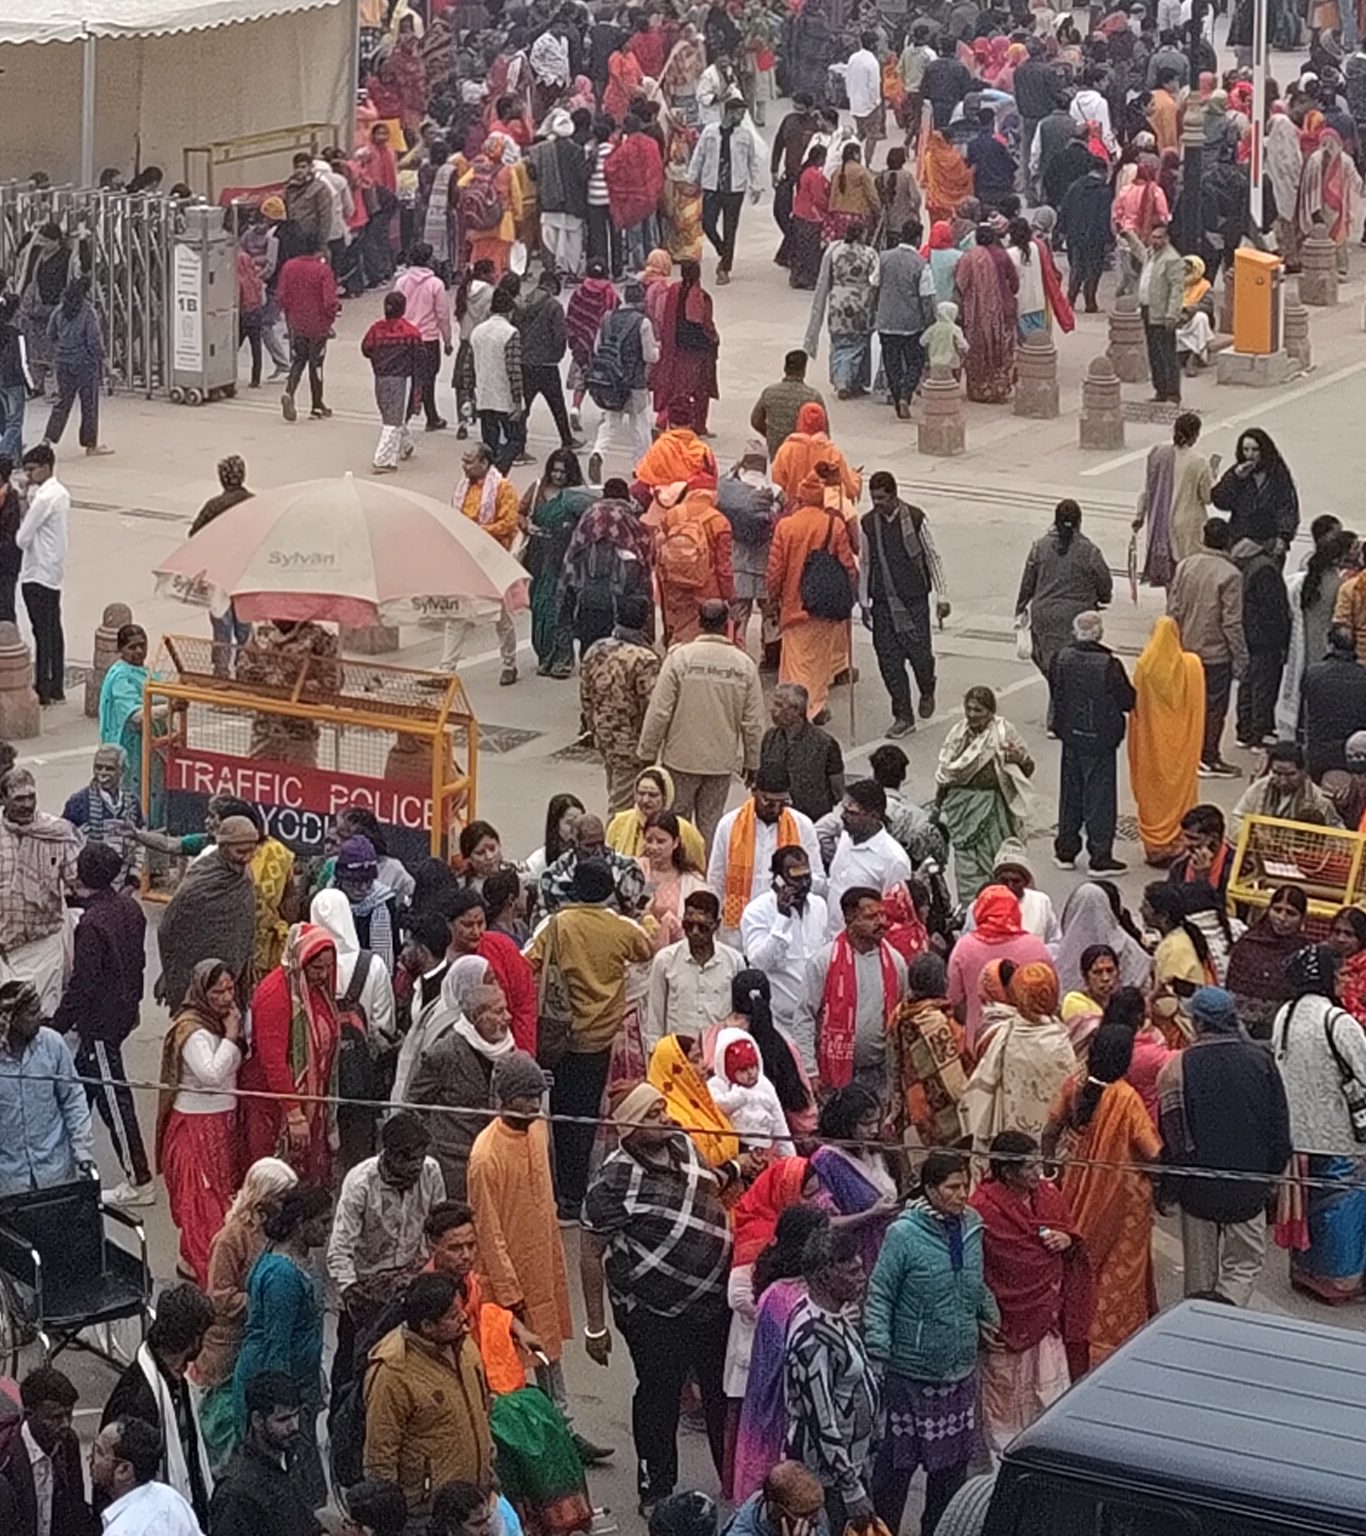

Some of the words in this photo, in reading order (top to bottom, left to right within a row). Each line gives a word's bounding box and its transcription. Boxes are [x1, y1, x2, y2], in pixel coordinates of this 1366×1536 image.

[268, 551, 335, 568] Sylvan
[411, 596, 460, 615] Sylvan
[175, 759, 303, 808] TRAFFIC
